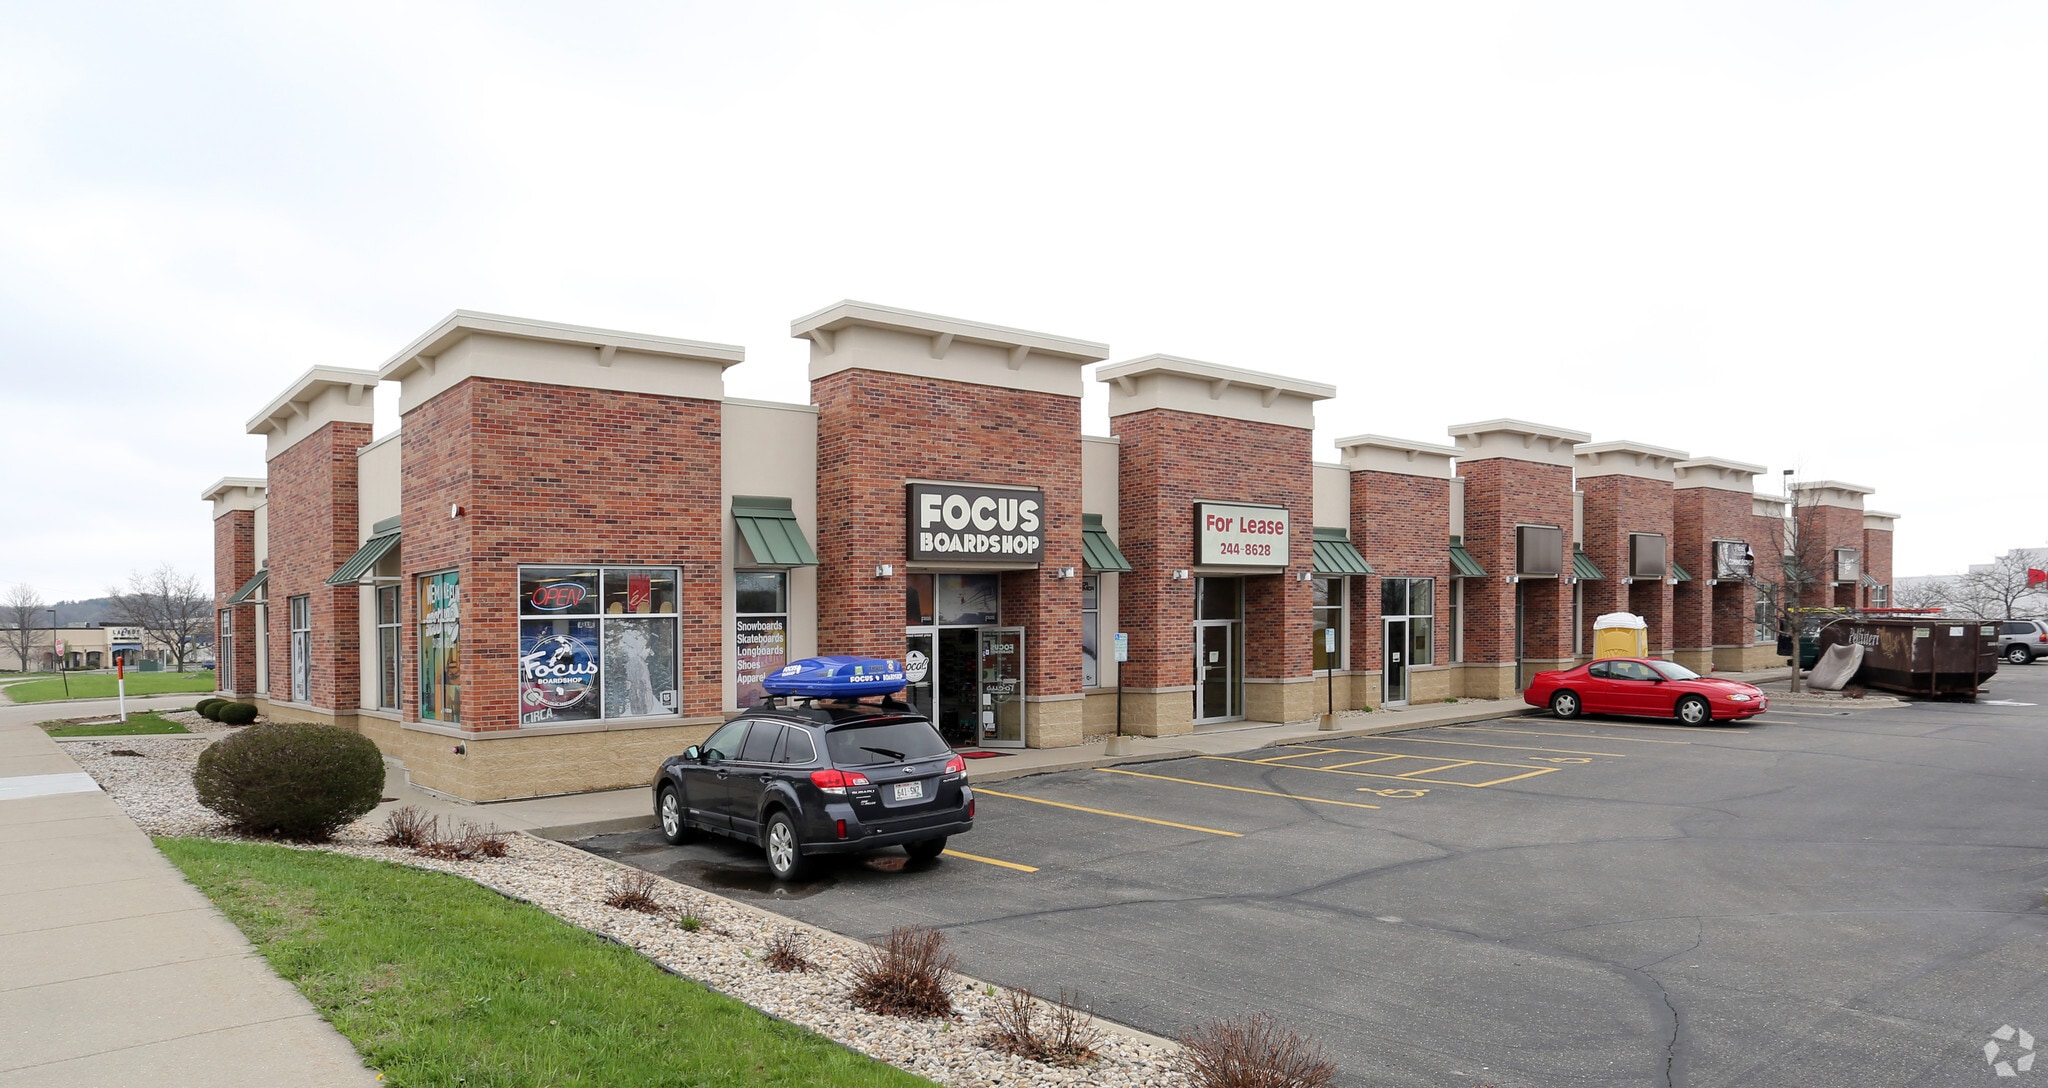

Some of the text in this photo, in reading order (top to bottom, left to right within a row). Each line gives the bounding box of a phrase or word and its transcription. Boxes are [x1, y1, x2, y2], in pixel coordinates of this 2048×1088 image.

[920, 493, 1040, 532] FOCUS
[1206, 514, 1284, 535] For Lease
[920, 532, 1040, 554] BOARDSHOP
[1220, 542, 1271, 556] 244-8628
[533, 587, 582, 606] OPEN
[737, 621, 783, 631] Snowboards
[737, 633, 784, 644] Skateboards
[737, 645, 784, 658] Longboards
[520, 651, 598, 679] Focus
[737, 659, 761, 670] Shoes
[906, 656, 930, 671] ocal
[737, 672, 766, 685] Apparel
[850, 675, 874, 683] FOCUS
[523, 707, 553, 724] CIRCA
